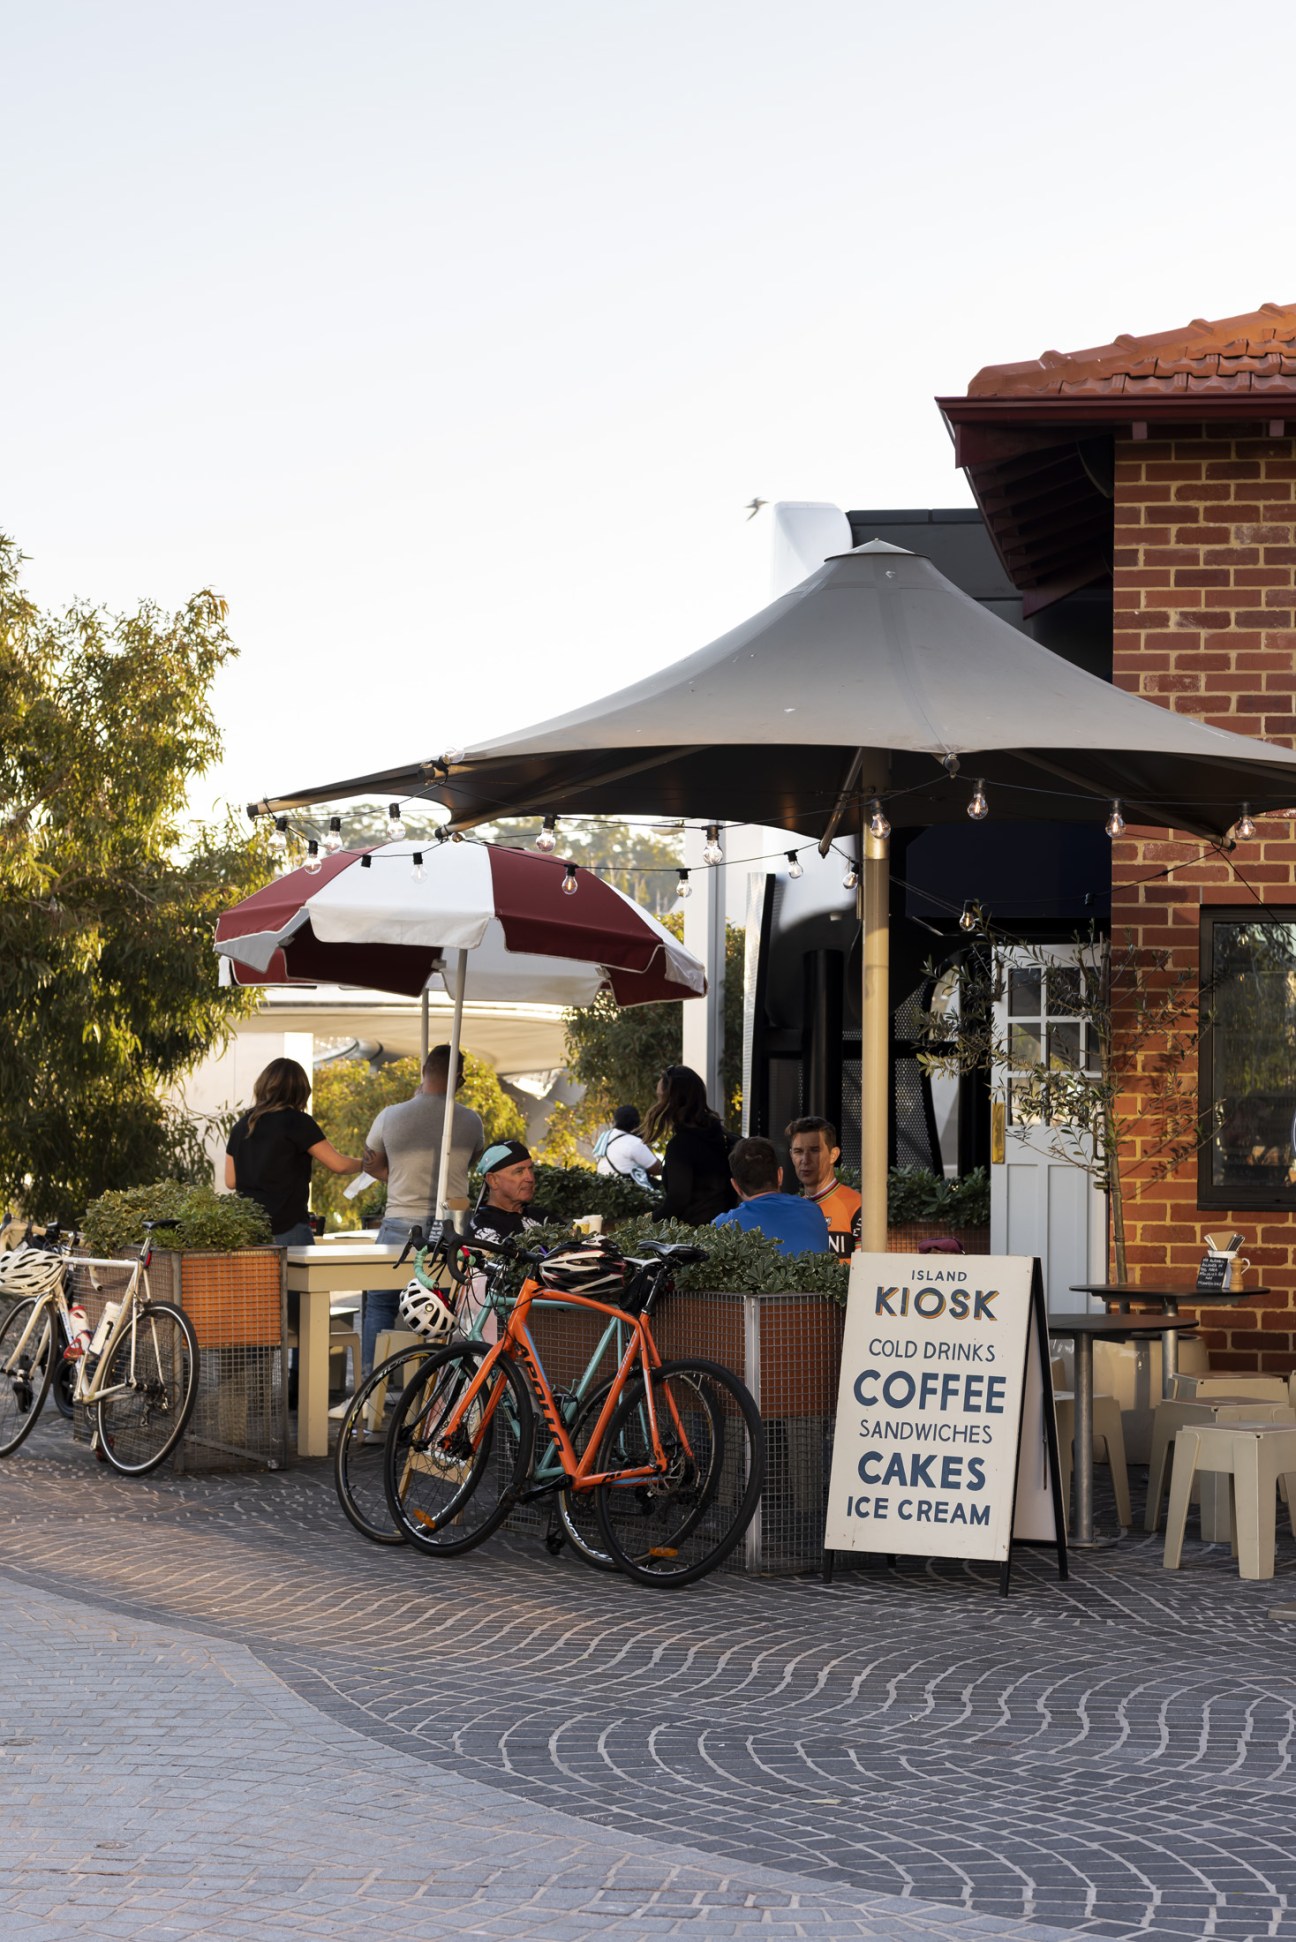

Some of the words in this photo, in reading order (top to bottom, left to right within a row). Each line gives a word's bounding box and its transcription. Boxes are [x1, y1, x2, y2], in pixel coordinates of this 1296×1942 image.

[911, 1269, 968, 1282] ISLAND
[874, 1286, 1000, 1322] KIOSK
[868, 1337, 918, 1359] COLD
[923, 1341, 996, 1363] DRINKS
[853, 1368, 1007, 1414] COFFEE
[858, 1418, 993, 1445] SANDWICHES
[857, 1450, 986, 1492] CAKES
[846, 1495, 889, 1520] ICE
[897, 1499, 991, 1526] CREAM
